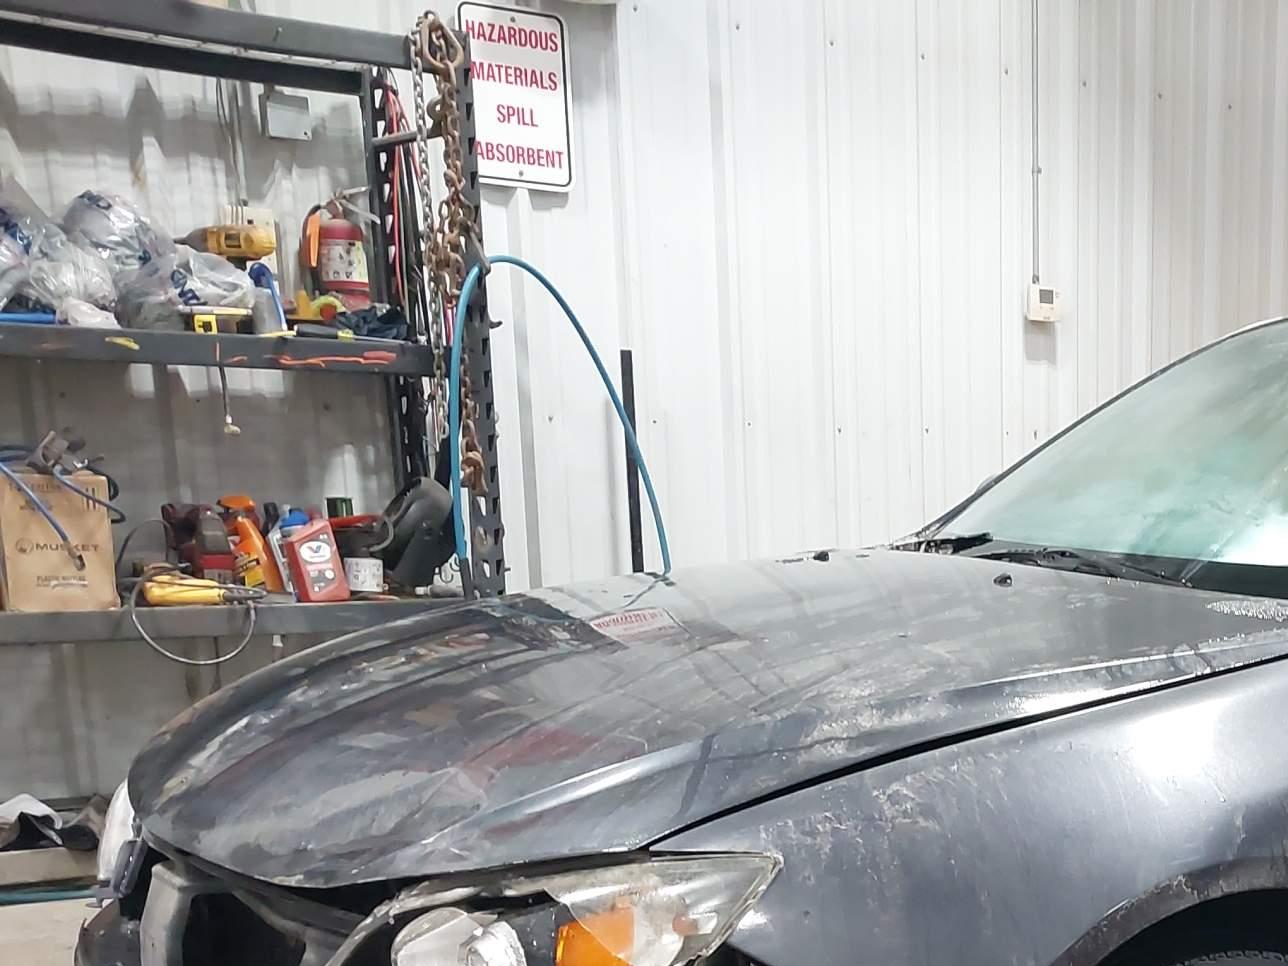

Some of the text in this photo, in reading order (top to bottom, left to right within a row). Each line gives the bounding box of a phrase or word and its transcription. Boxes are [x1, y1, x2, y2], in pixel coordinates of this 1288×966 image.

[465, 19, 559, 53] HAZARDOUS
[470, 61, 558, 92] MATERIALS
[496, 103, 539, 128] SPILL
[474, 139, 564, 170] ABSORBENT
